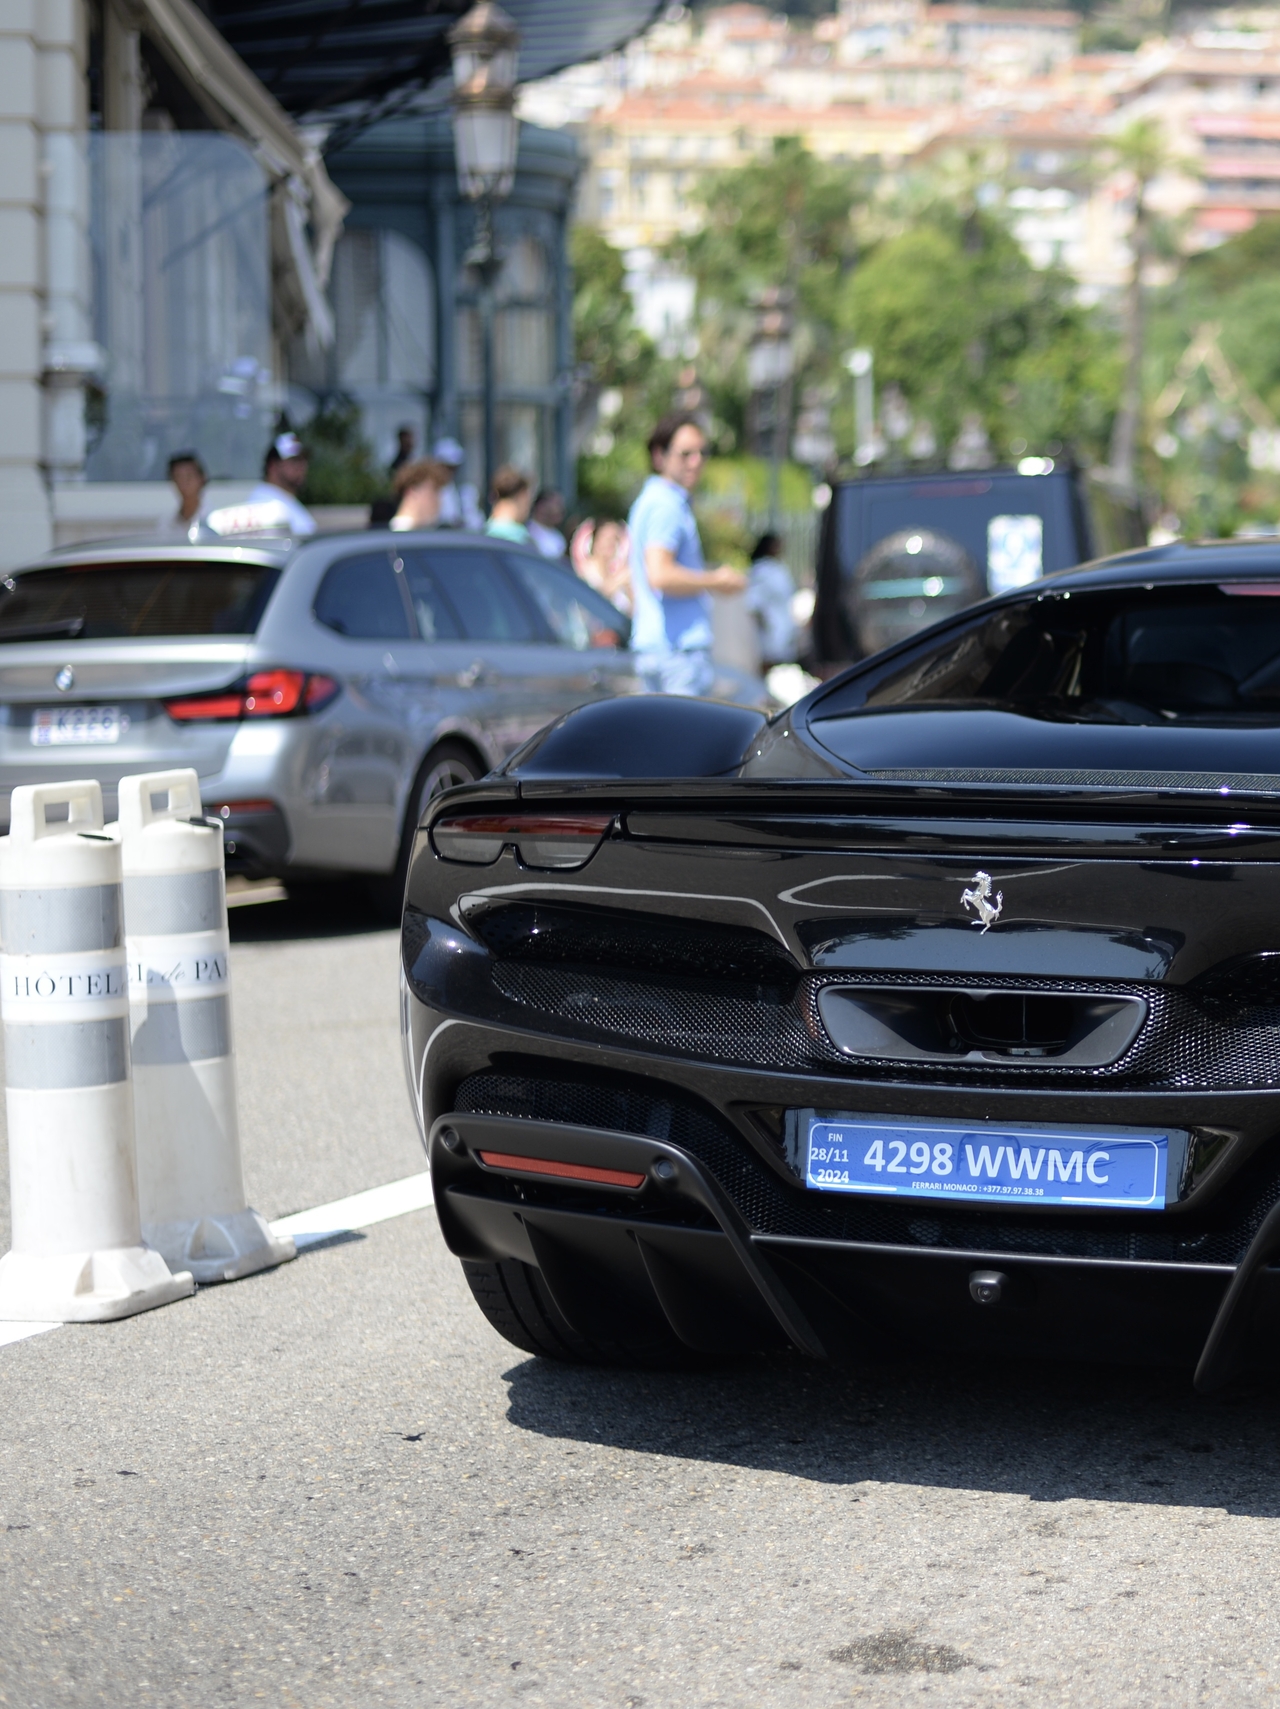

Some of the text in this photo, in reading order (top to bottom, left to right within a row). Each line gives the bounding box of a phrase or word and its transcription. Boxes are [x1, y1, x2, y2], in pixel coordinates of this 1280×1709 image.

[14, 970, 118, 997] HÔTEL
[828, 1132, 843, 1143] FIN
[810, 1147, 849, 1163] 28/11
[863, 1139, 1110, 1184] 4298 WWMC
[816, 1168, 850, 1184] 2024
[911, 1181, 942, 1191] FERRARI
[943, 1183, 978, 1192] MONACO
[983, 1185, 1044, 1196] +377.97.97.38.38
